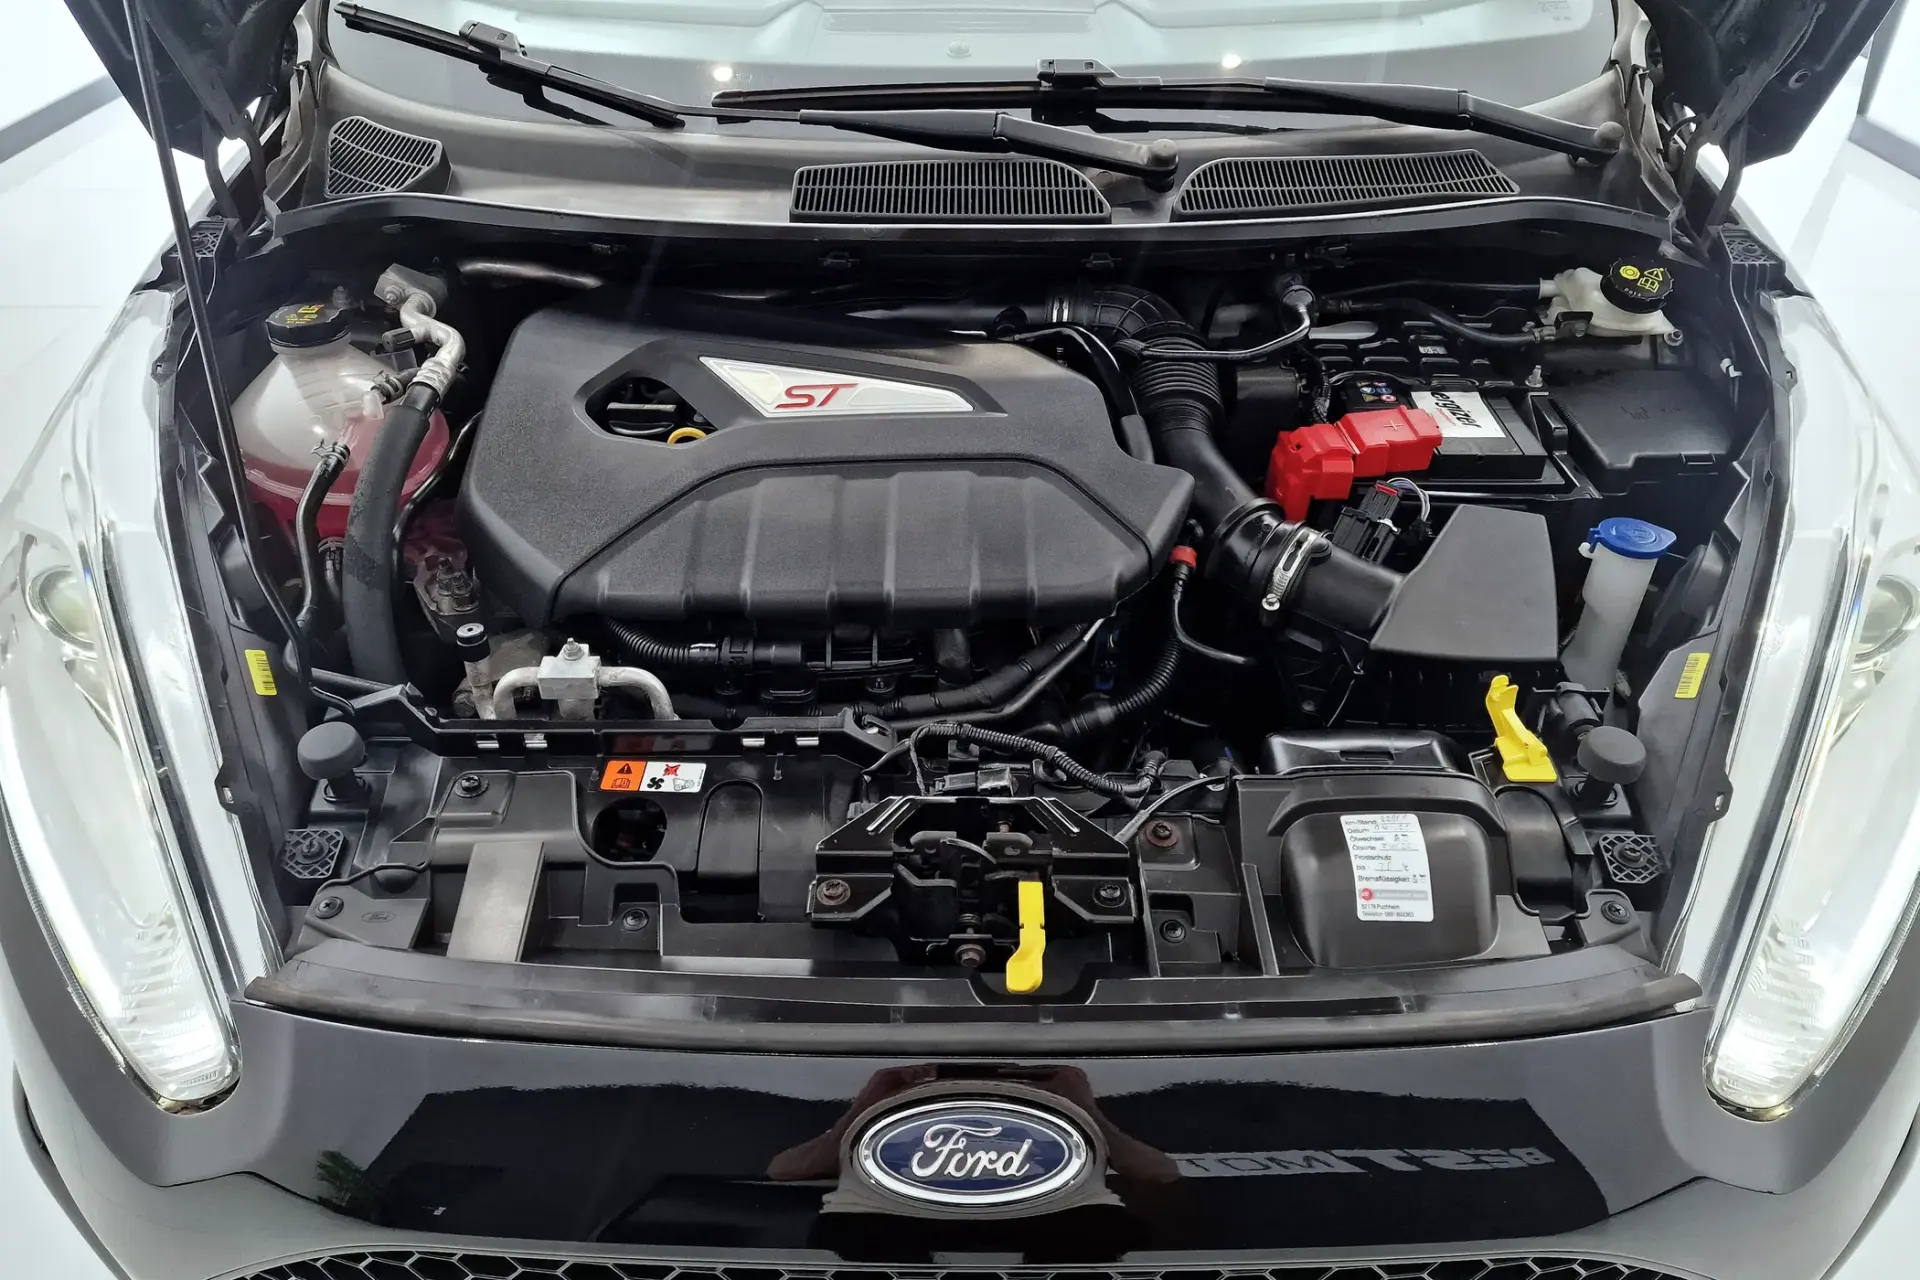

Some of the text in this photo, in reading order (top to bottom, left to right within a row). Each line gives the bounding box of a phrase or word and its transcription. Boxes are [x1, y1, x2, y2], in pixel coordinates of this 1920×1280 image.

[774, 383, 859, 409] ST
[1431, 391, 1482, 428] ergizer
[911, 1123, 1033, 1177] Ford
